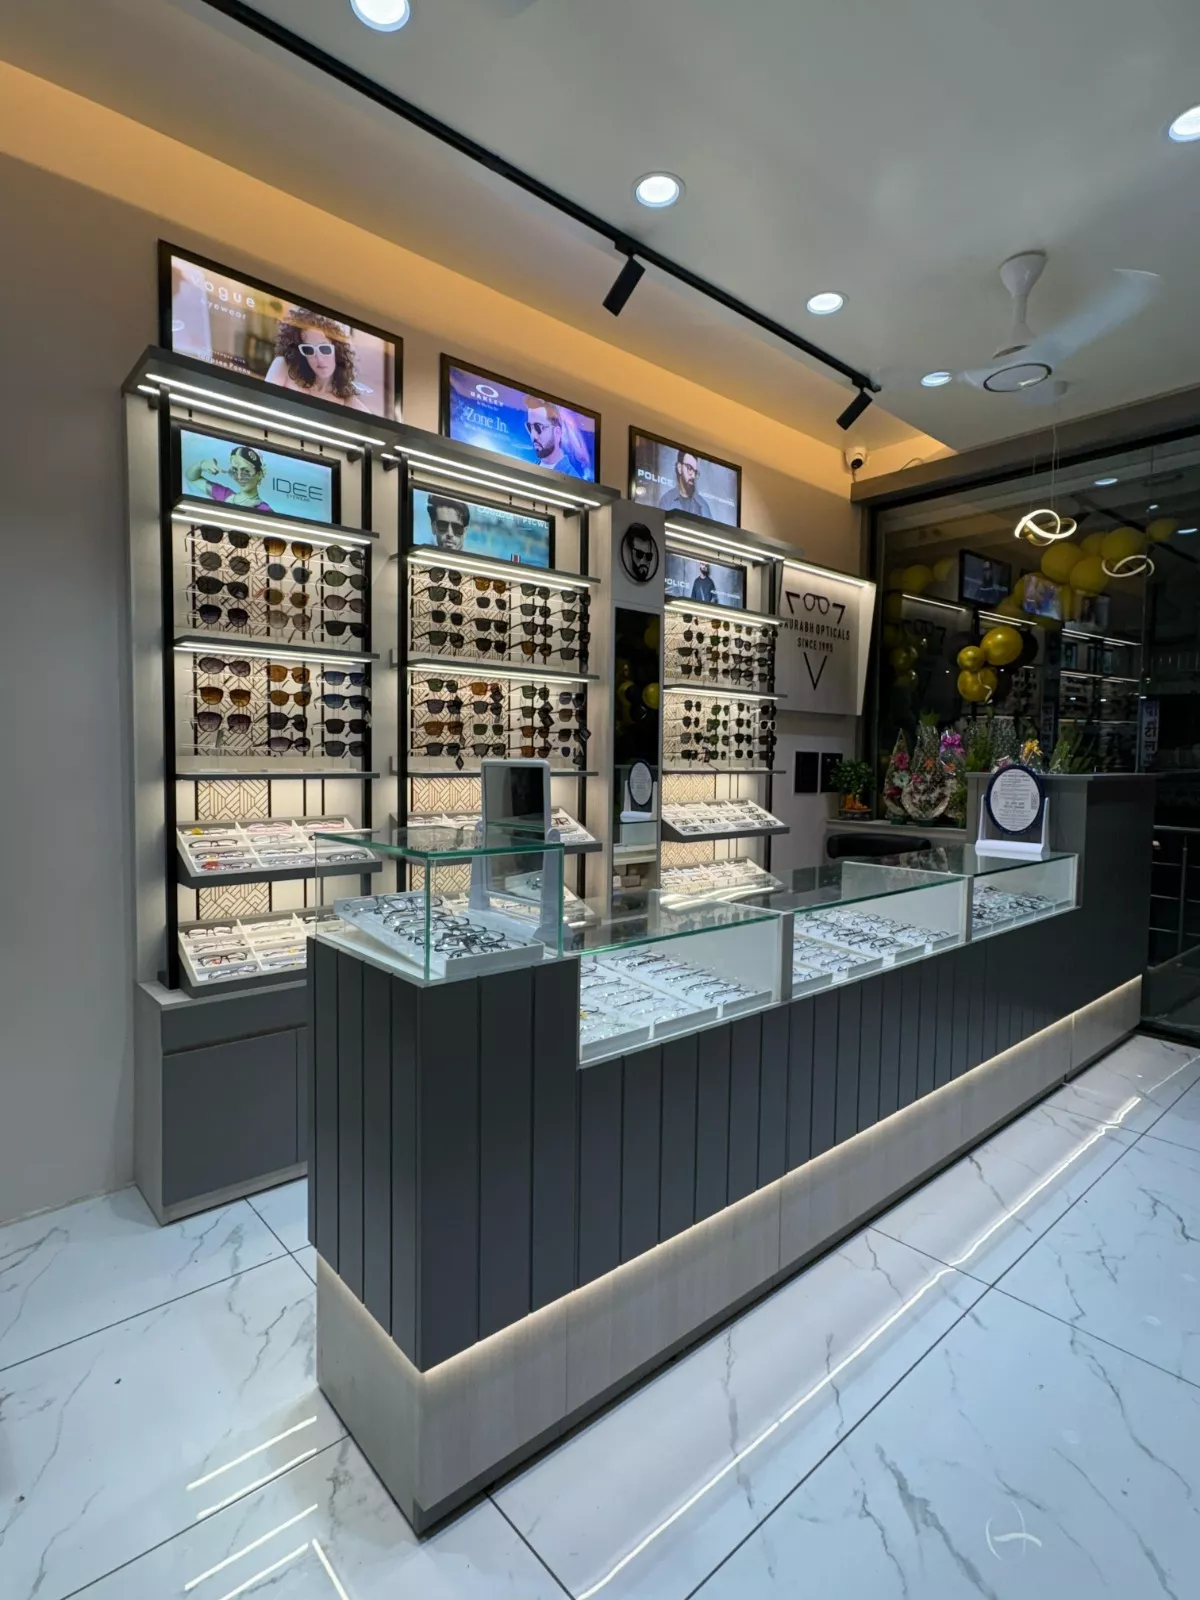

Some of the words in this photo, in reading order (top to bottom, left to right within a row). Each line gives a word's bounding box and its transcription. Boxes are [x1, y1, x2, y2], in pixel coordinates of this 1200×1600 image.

[470, 390, 504, 407] OAKLEY
[466, 406, 494, 429] Zone
[637, 468, 675, 487] POLICE
[272, 477, 323, 502] IDEE
[815, 623, 850, 641] OPTICALS
[797, 637, 817, 651] SINCE
